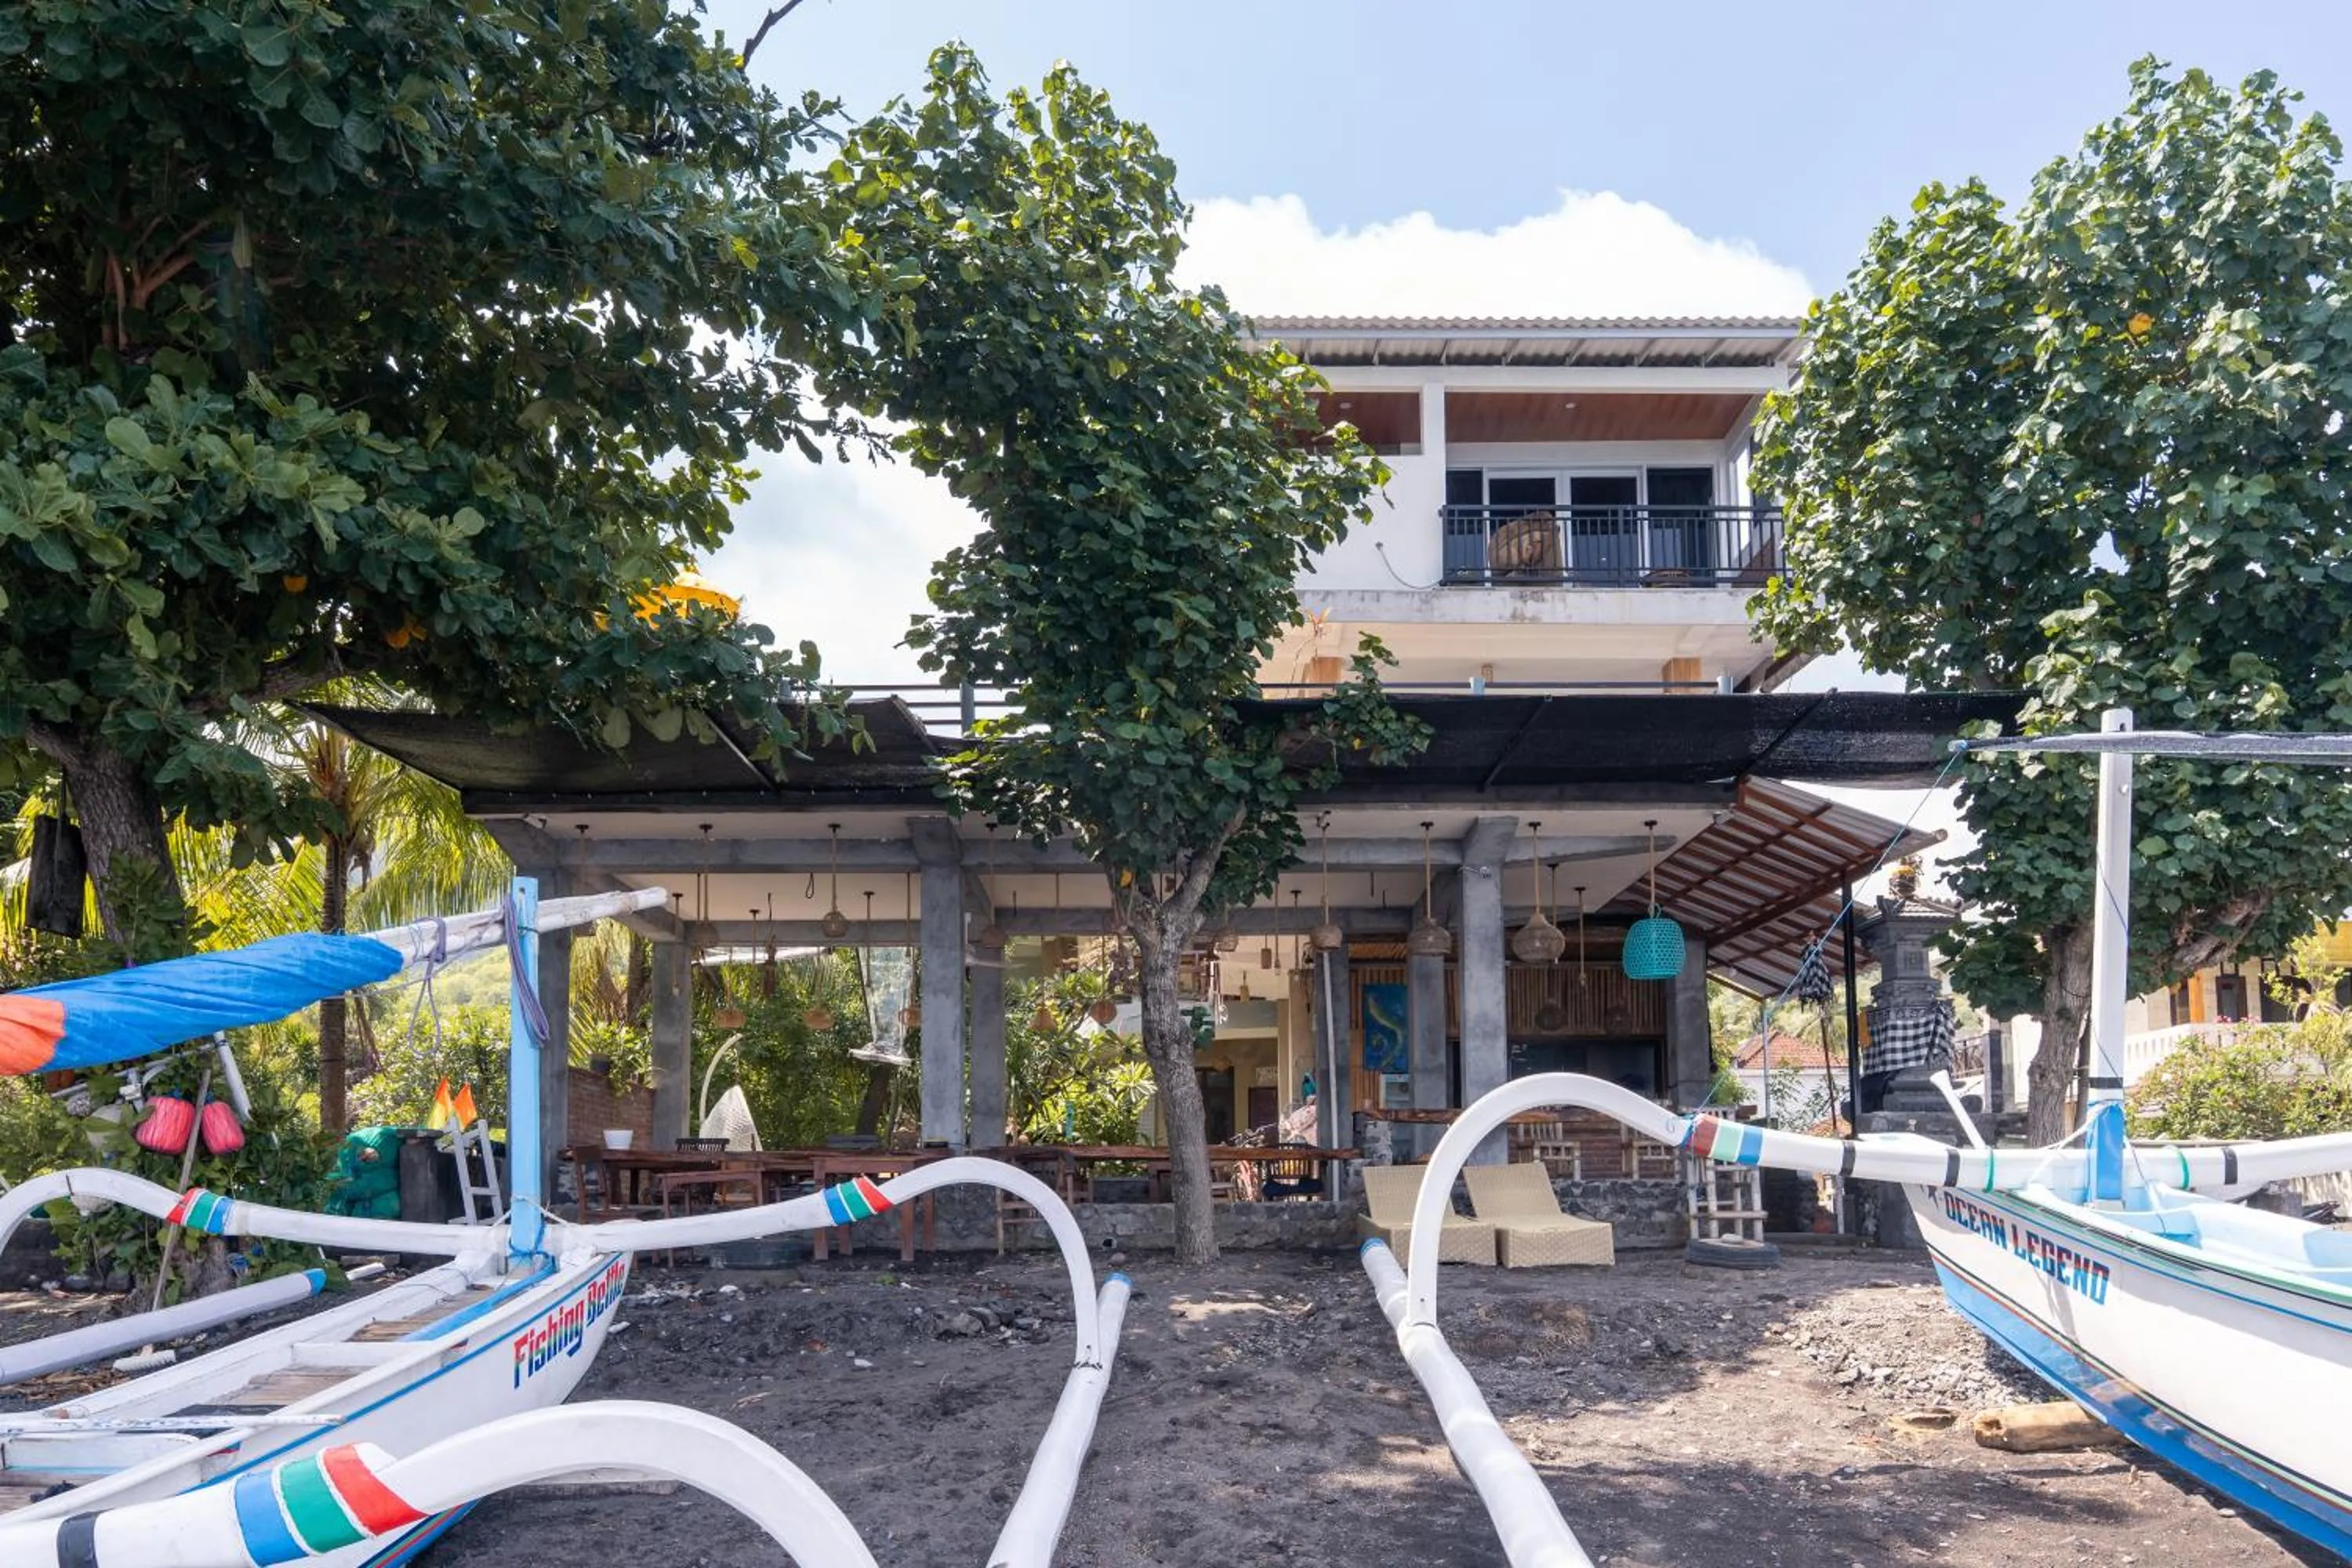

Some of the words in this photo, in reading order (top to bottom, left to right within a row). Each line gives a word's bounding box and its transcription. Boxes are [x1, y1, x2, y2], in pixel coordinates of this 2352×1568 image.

[1944, 1191, 2008, 1250] OCEAN
[2011, 1223, 2110, 1305] LEGEND
[514, 1299, 584, 1389] Fishing
